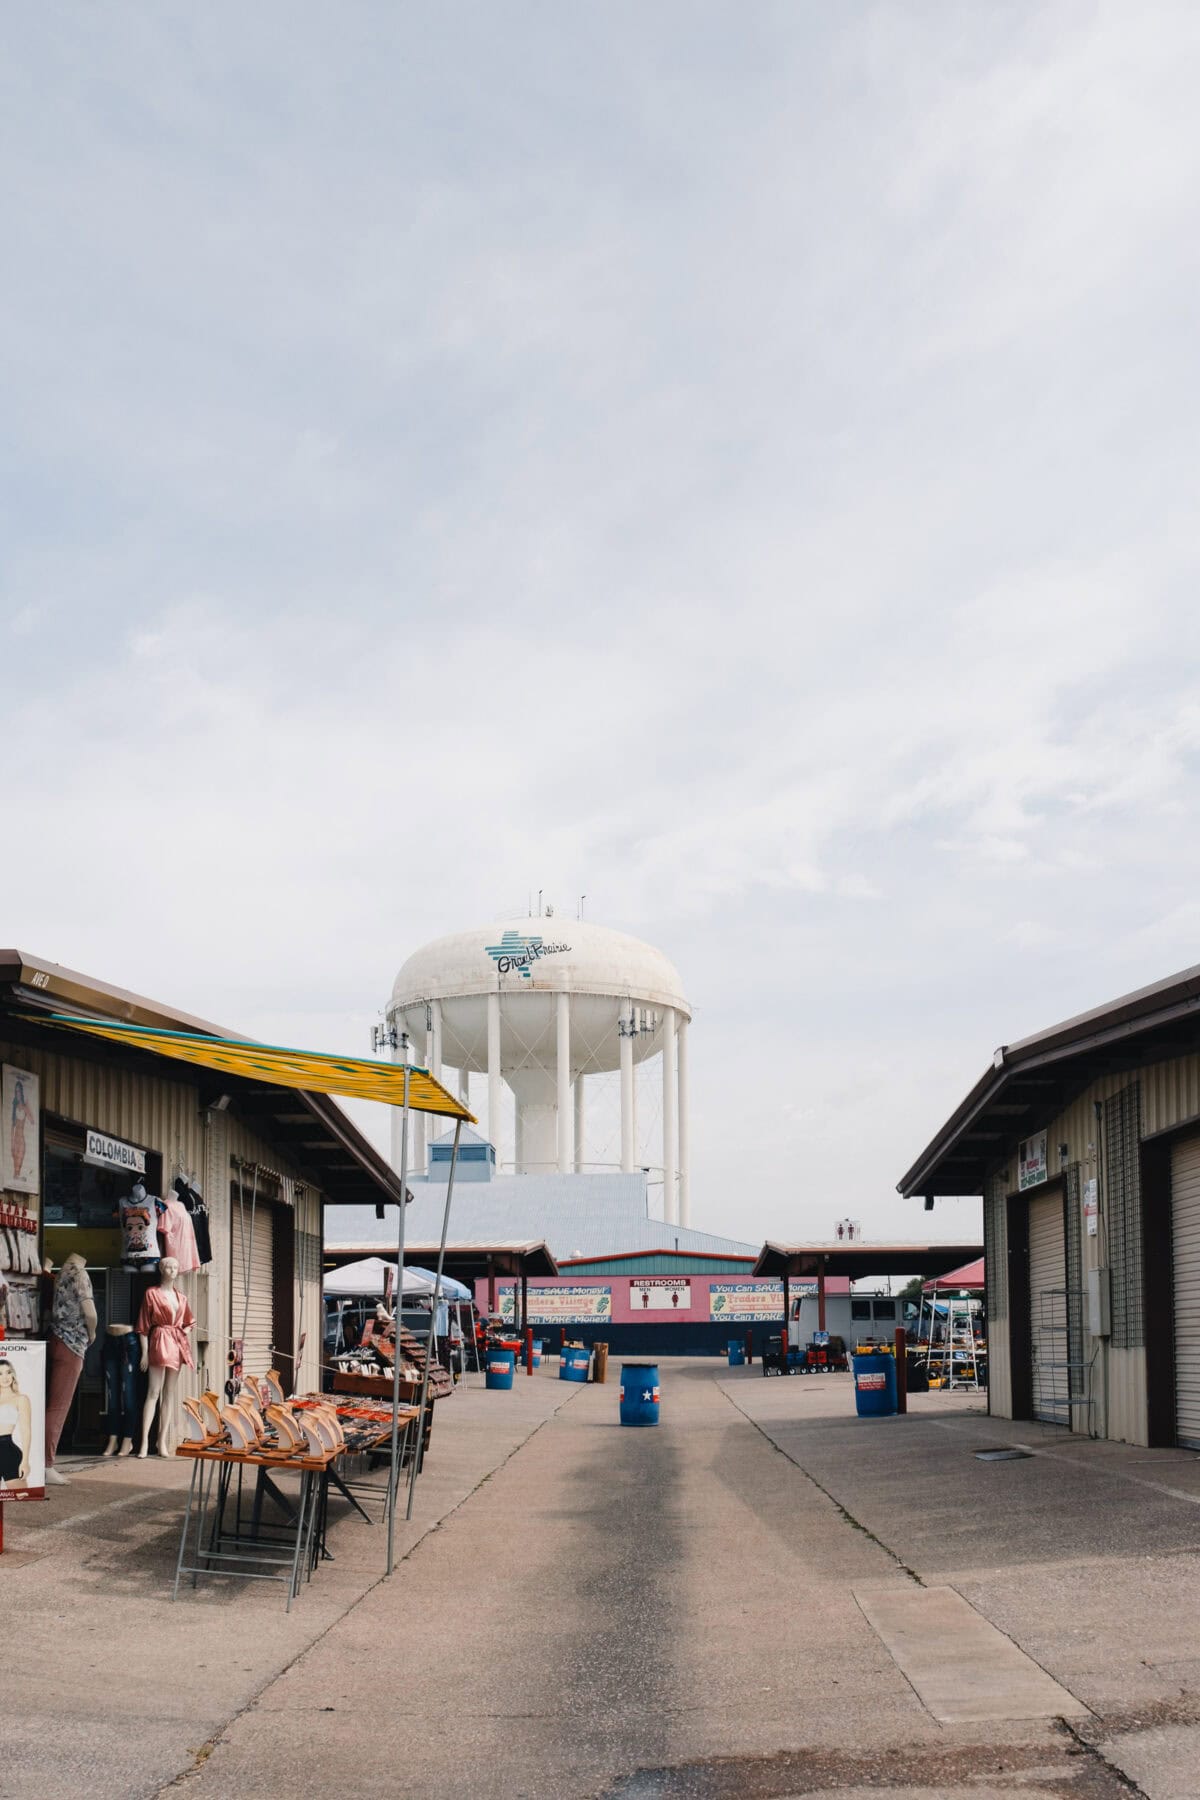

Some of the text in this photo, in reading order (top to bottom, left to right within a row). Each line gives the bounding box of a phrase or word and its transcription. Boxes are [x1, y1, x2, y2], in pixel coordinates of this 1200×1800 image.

[531, 942, 572, 958] Prairie
[89, 1135, 137, 1167] COLOMBIA
[572, 1287, 605, 1295] Money!
[755, 1284, 781, 1292] SAVE
[726, 1294, 765, 1303] Traders
[543, 1315, 571, 1323] MAKE
[574, 1315, 609, 1323] Money!
[713, 1313, 783, 1321] You Can MAKE
